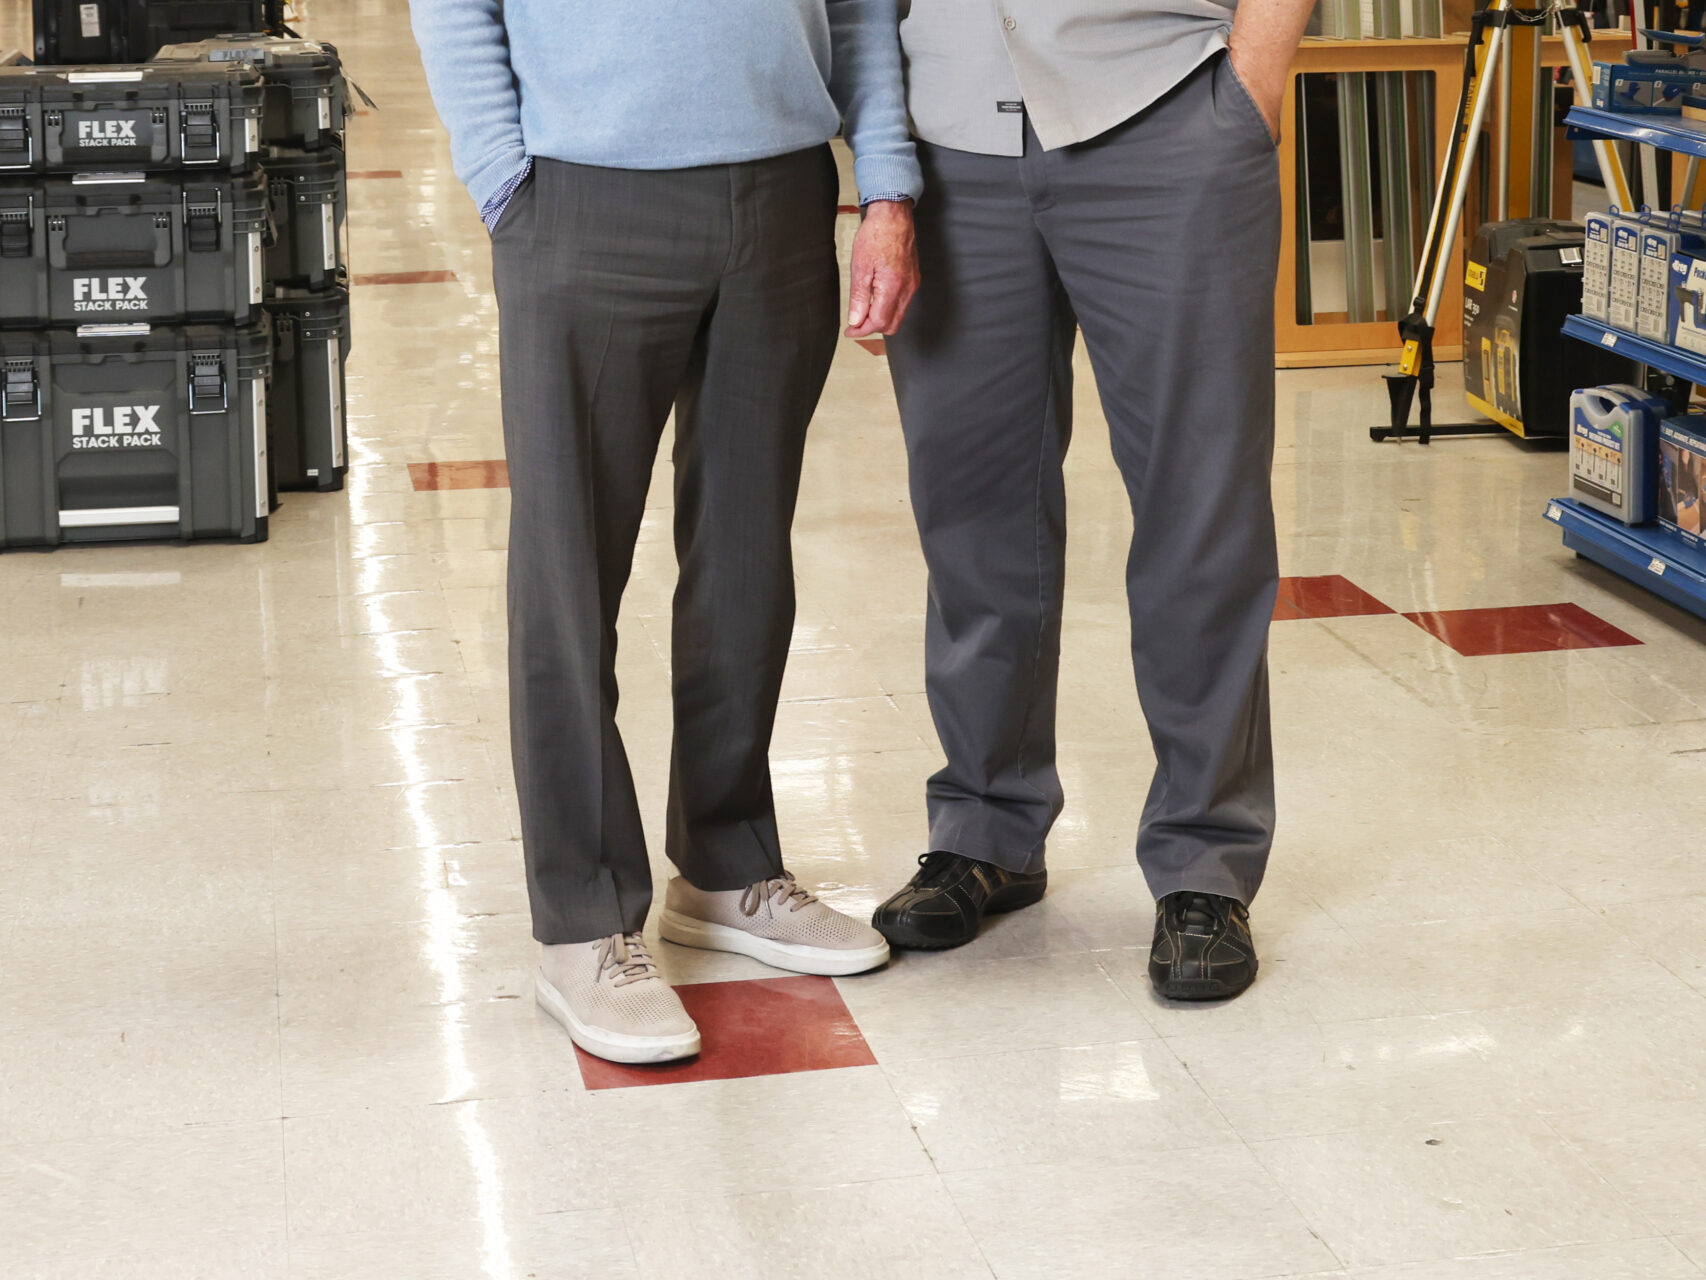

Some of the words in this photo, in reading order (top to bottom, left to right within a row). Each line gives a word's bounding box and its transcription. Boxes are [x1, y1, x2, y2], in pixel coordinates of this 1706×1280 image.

[78, 120, 137, 138] FLEX
[79, 138, 109, 147] STACK
[111, 138, 137, 146] PACK
[73, 277, 147, 301] FLEX
[74, 301, 113, 312] STACK
[115, 300, 148, 310] PACK
[72, 405, 161, 436] FLEX
[73, 435, 119, 448] STACK
[123, 434, 161, 447] PACK
